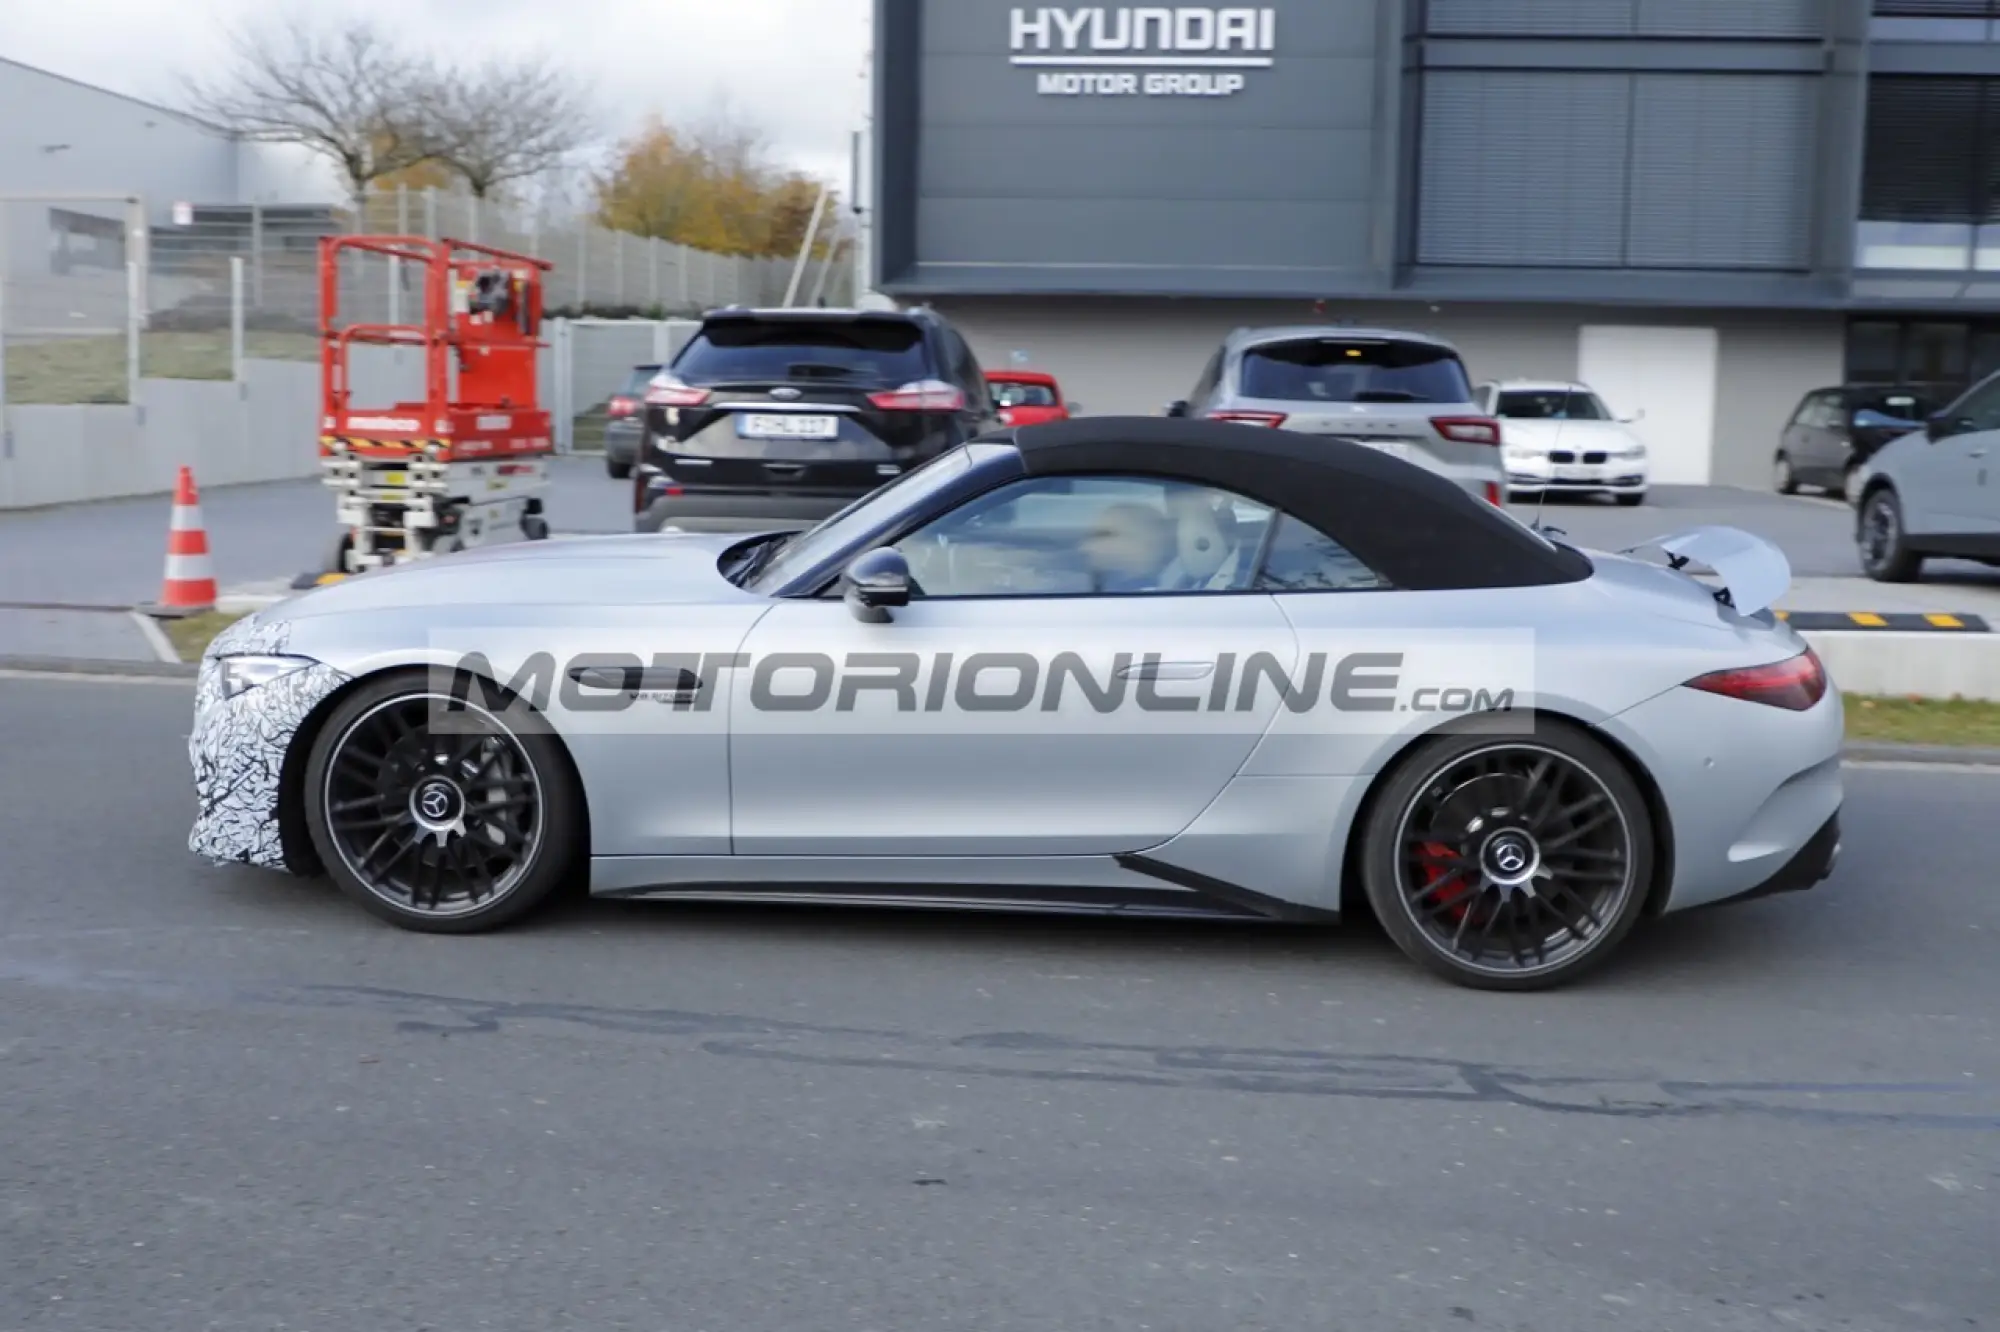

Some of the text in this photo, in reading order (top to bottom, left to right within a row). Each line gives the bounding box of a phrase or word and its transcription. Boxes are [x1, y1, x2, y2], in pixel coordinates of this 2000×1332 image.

[1009, 7, 1275, 50] HYUNDAI
[1036, 73, 1244, 95] MOTOR GROUP
